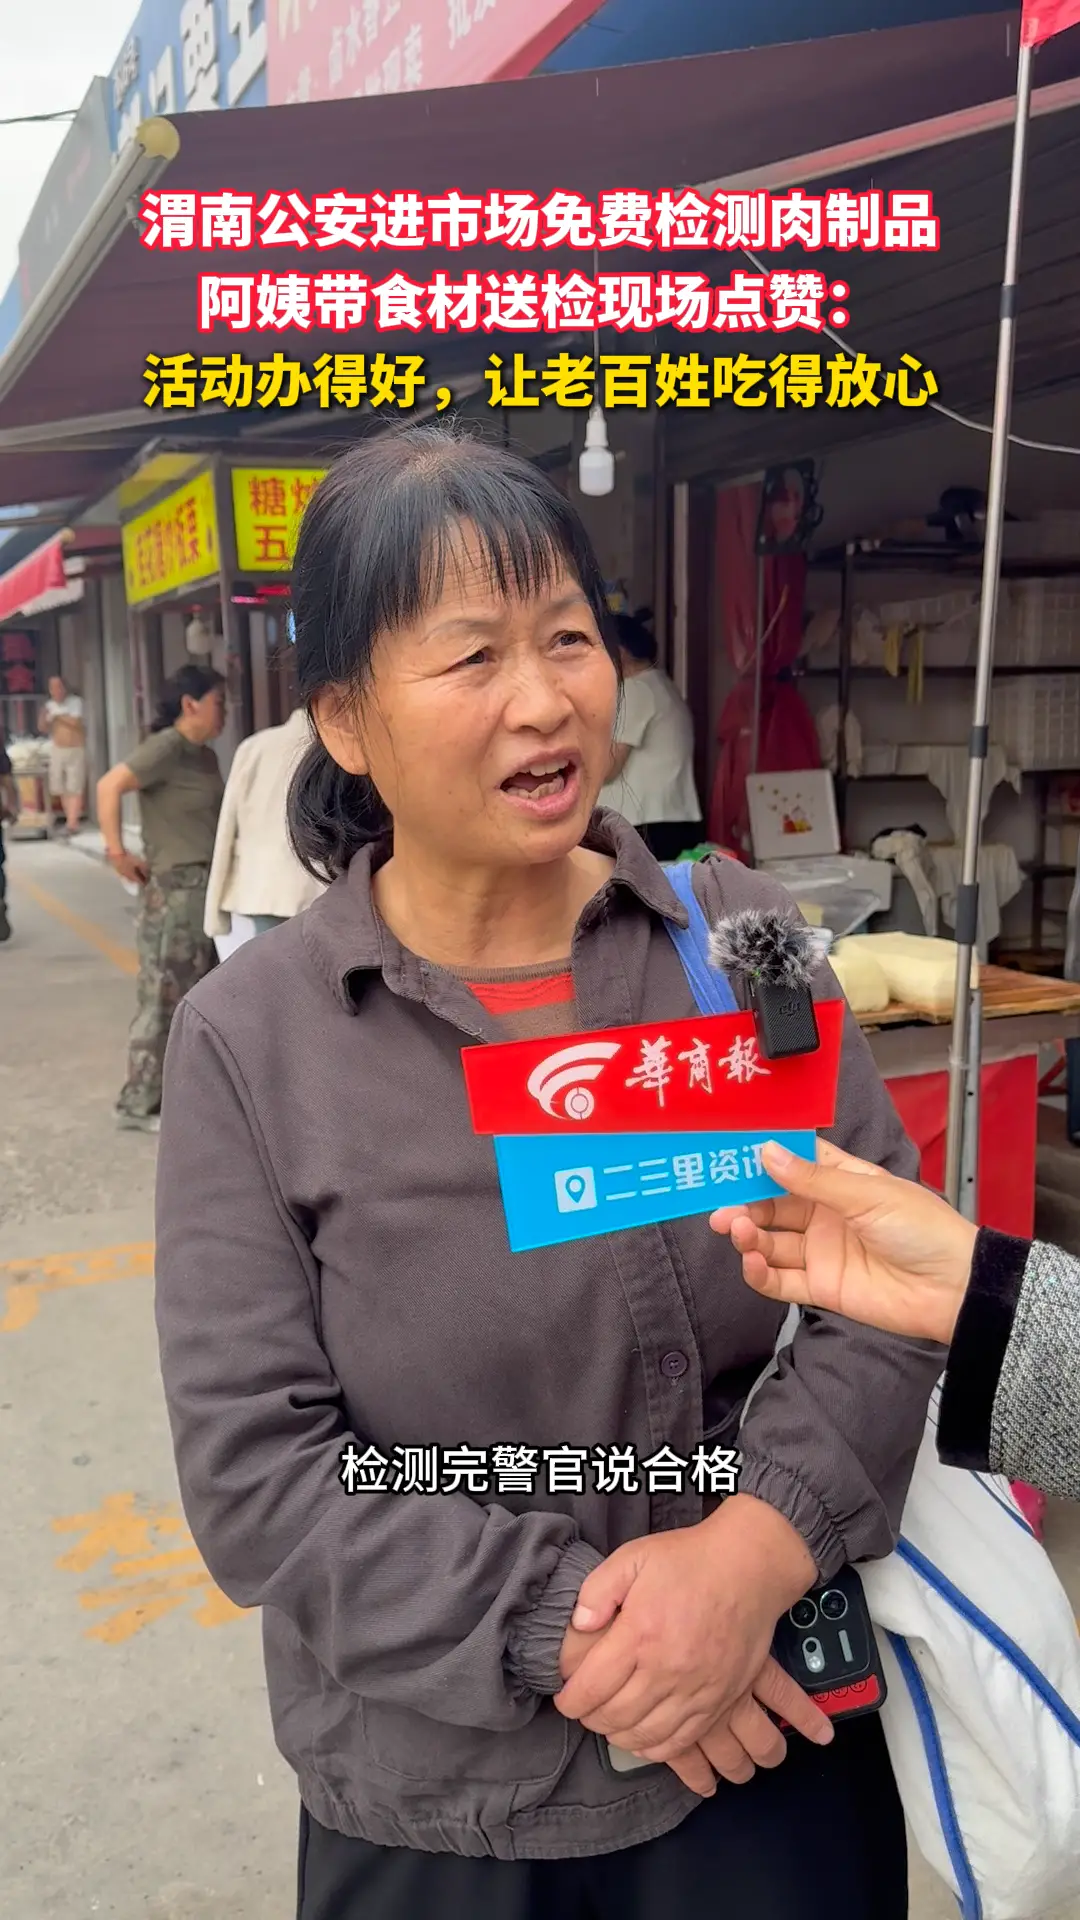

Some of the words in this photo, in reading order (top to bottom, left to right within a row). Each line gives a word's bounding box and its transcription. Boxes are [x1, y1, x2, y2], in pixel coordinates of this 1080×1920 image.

[602, 1141, 763, 1202] 二三里资讯
